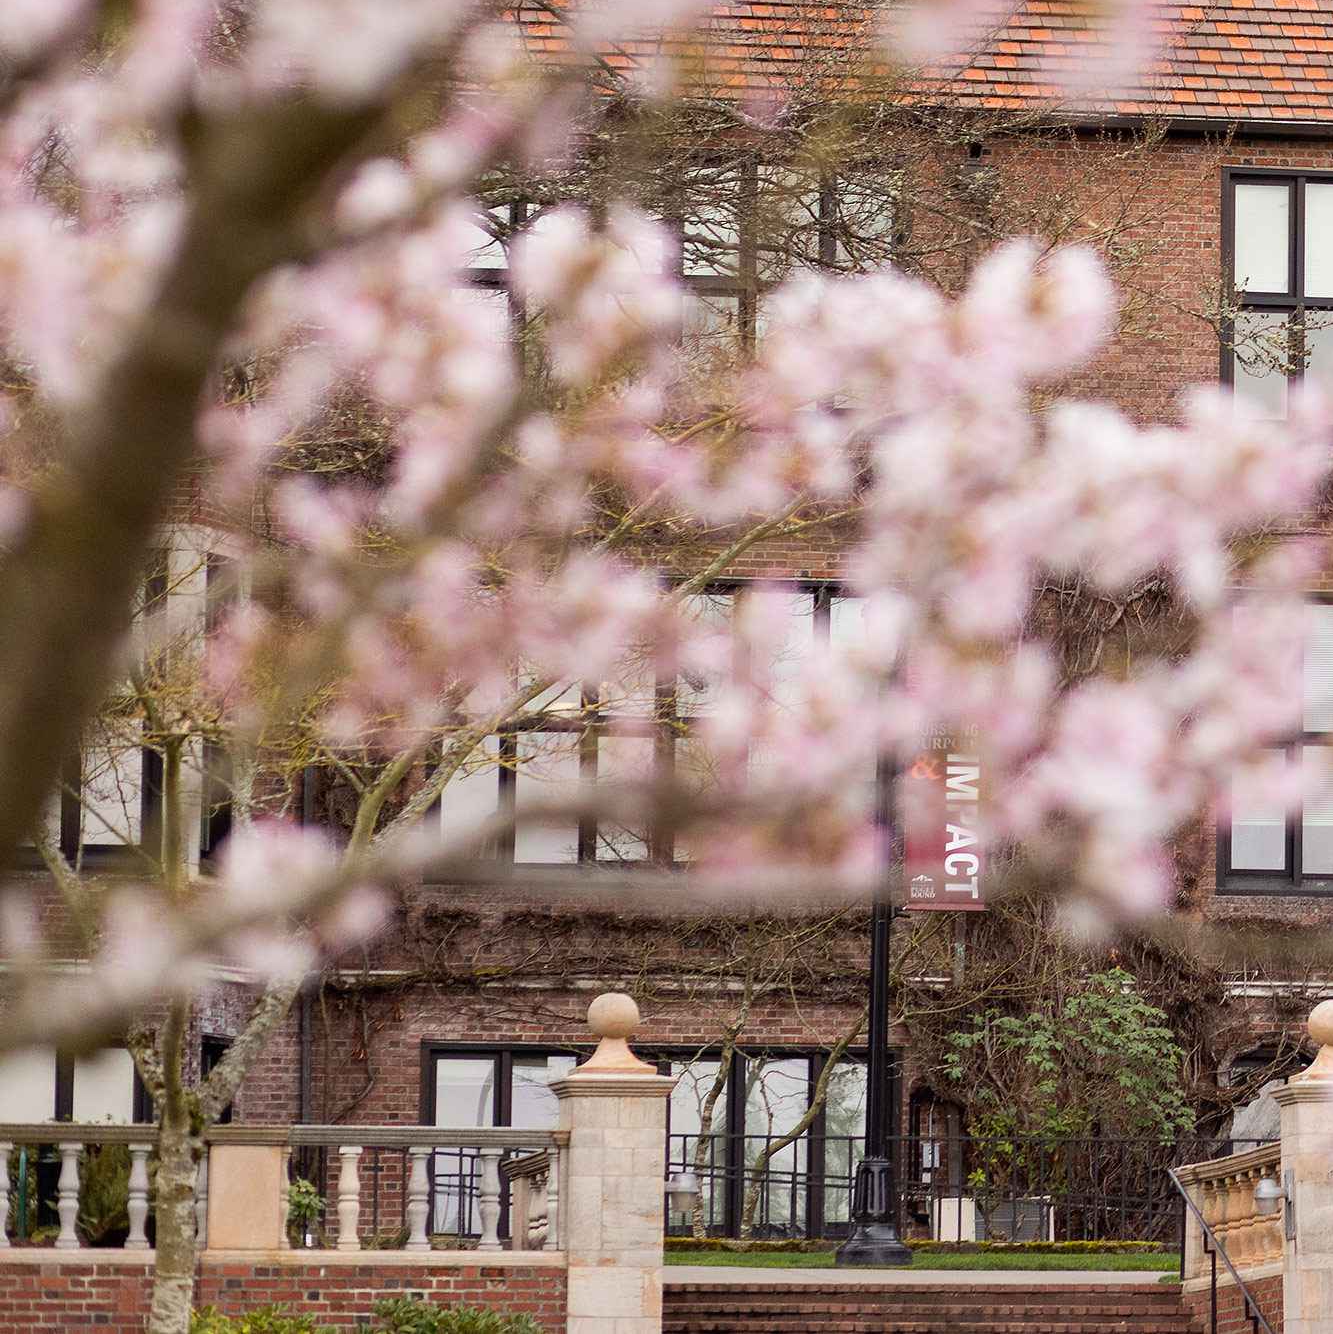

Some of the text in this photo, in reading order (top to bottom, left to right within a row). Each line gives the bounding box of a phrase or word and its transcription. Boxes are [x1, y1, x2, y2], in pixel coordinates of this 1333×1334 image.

[913, 722, 979, 737] PURSUNG
[912, 737, 979, 750] PURPOE
[911, 754, 942, 780] &
[944, 753, 980, 899] IMPACT
